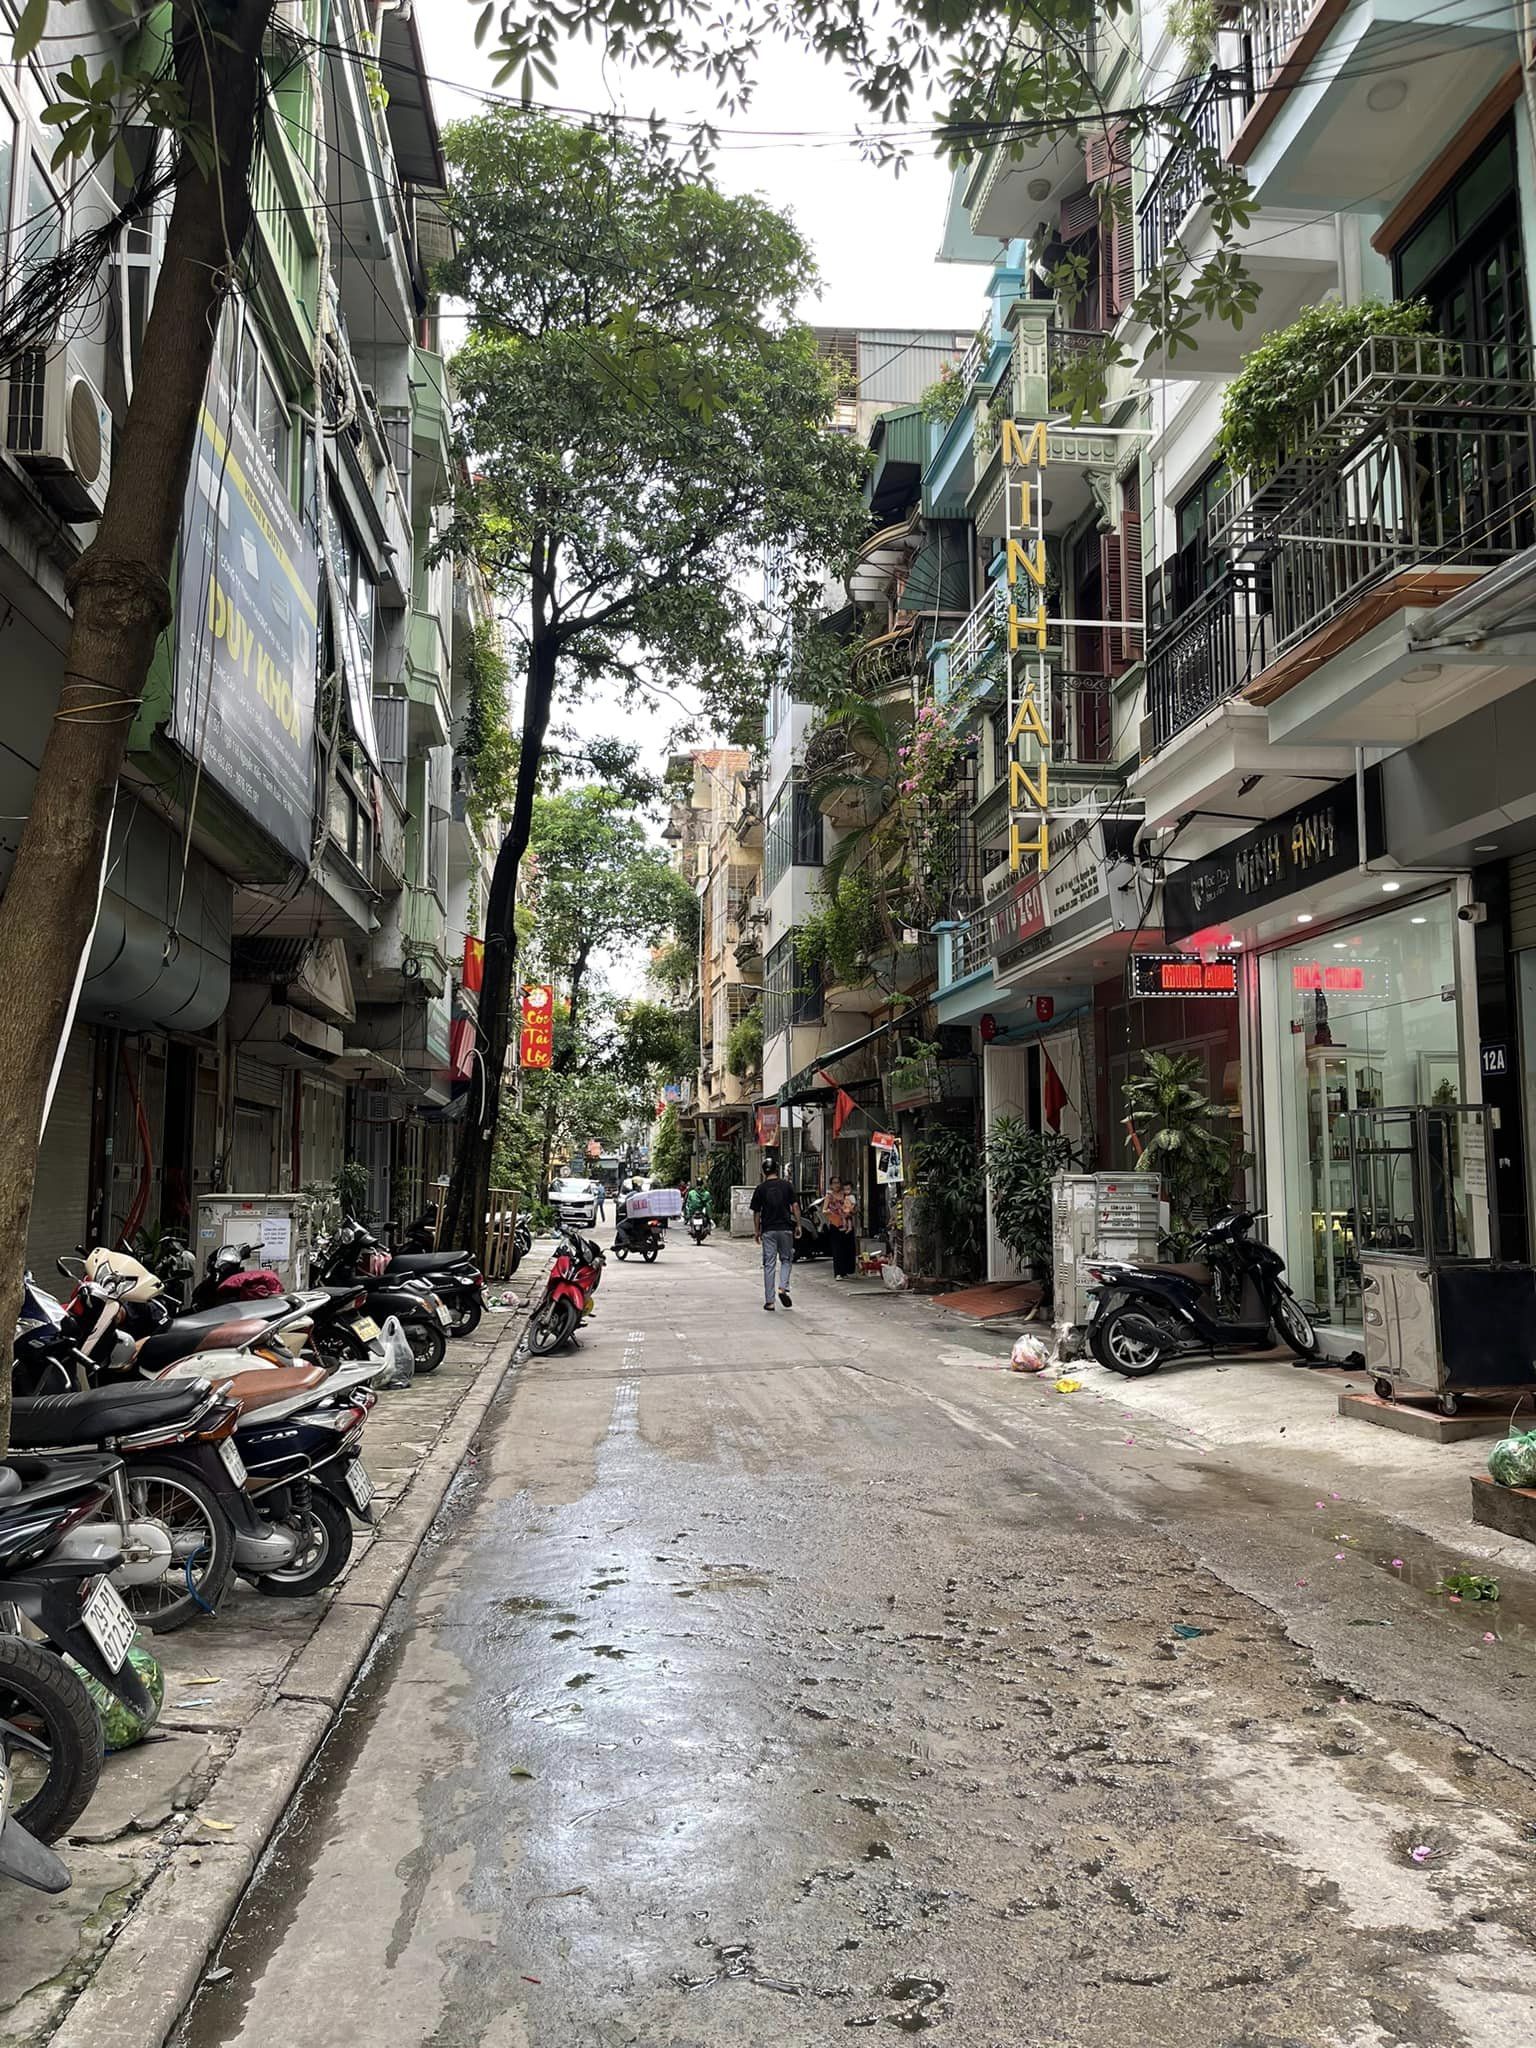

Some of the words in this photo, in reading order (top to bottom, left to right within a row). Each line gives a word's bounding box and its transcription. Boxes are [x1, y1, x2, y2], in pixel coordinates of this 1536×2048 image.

[244, 482, 266, 528] HEAVY
[266, 522, 284, 561] DUTY
[208, 572, 254, 678] DUY
[256, 641, 301, 750] KHOA
[523, 1028, 549, 1045] Tài
[527, 1047, 548, 1065] Lộc
[1483, 1050, 1505, 1071] 12A
[90, 1585, 118, 1636] 29-P1
[103, 1607, 135, 1666] 972.59
